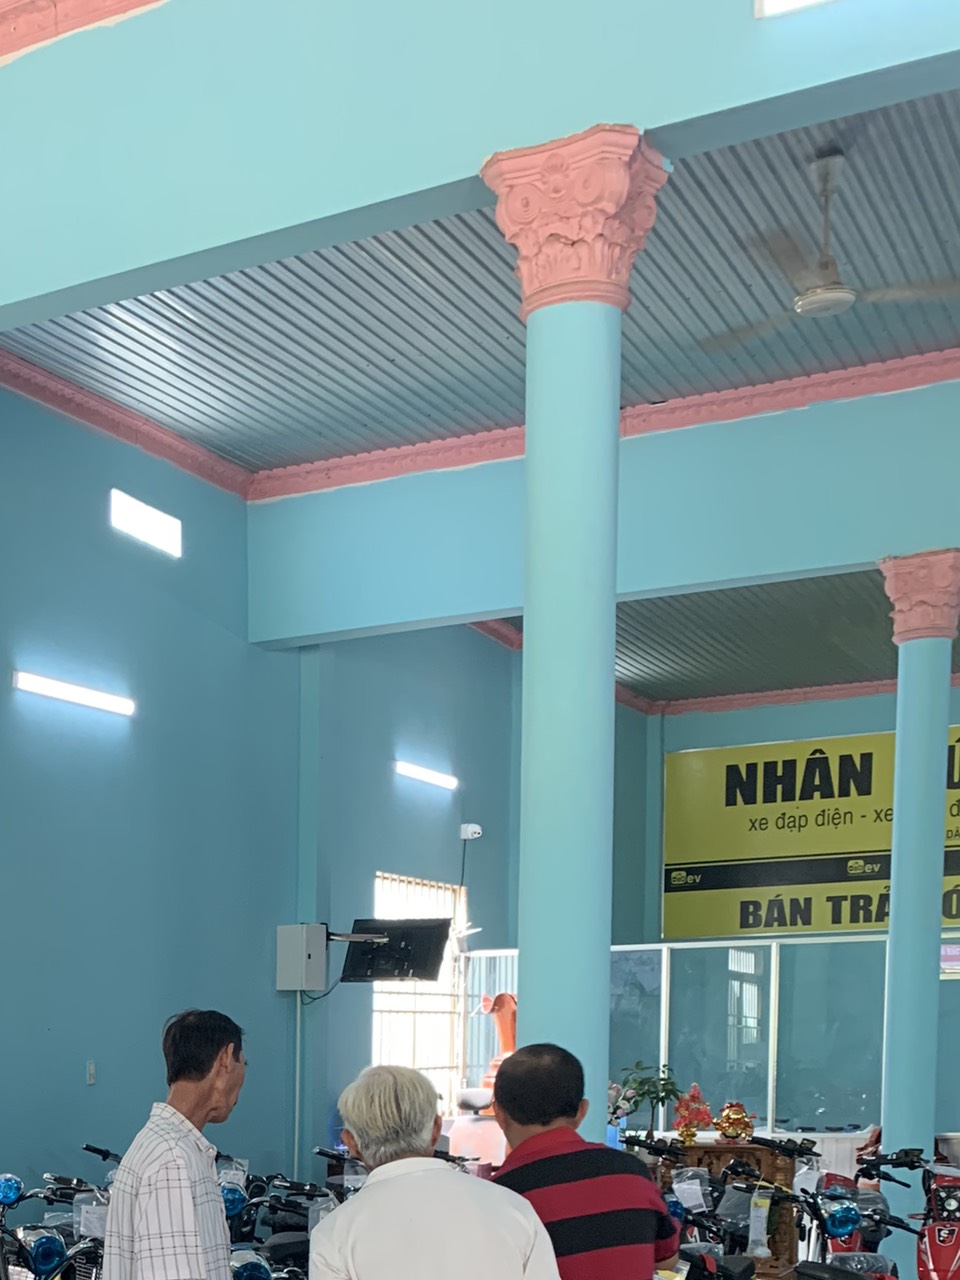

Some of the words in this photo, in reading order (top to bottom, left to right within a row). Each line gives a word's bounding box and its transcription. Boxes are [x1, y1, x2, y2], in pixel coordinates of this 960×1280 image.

[725, 748, 873, 807] NHÂN
[748, 816, 769, 832] xe
[775, 811, 809, 833] đạp
[814, 807, 854, 830] điện
[873, 807, 894, 824] xe
[739, 893, 813, 929] BÁN
